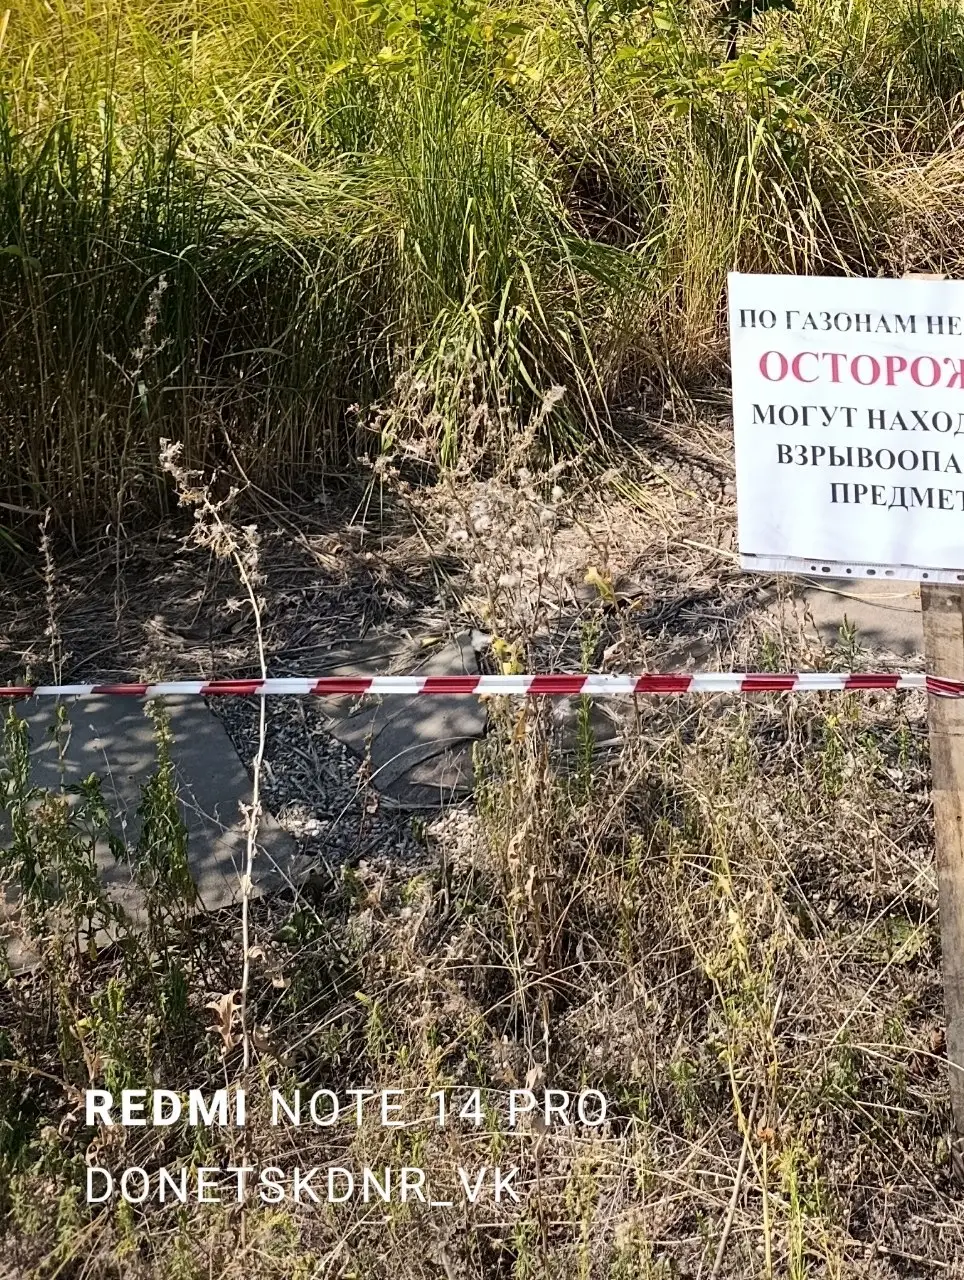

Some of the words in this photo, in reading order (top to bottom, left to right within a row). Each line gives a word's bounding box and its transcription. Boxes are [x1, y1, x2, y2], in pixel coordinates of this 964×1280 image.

[739, 309, 777, 329] ПО
[785, 310, 917, 335] ГАЗОНАМ
[926, 315, 962, 336] НЕ
[752, 403, 858, 428] МОГУТ
